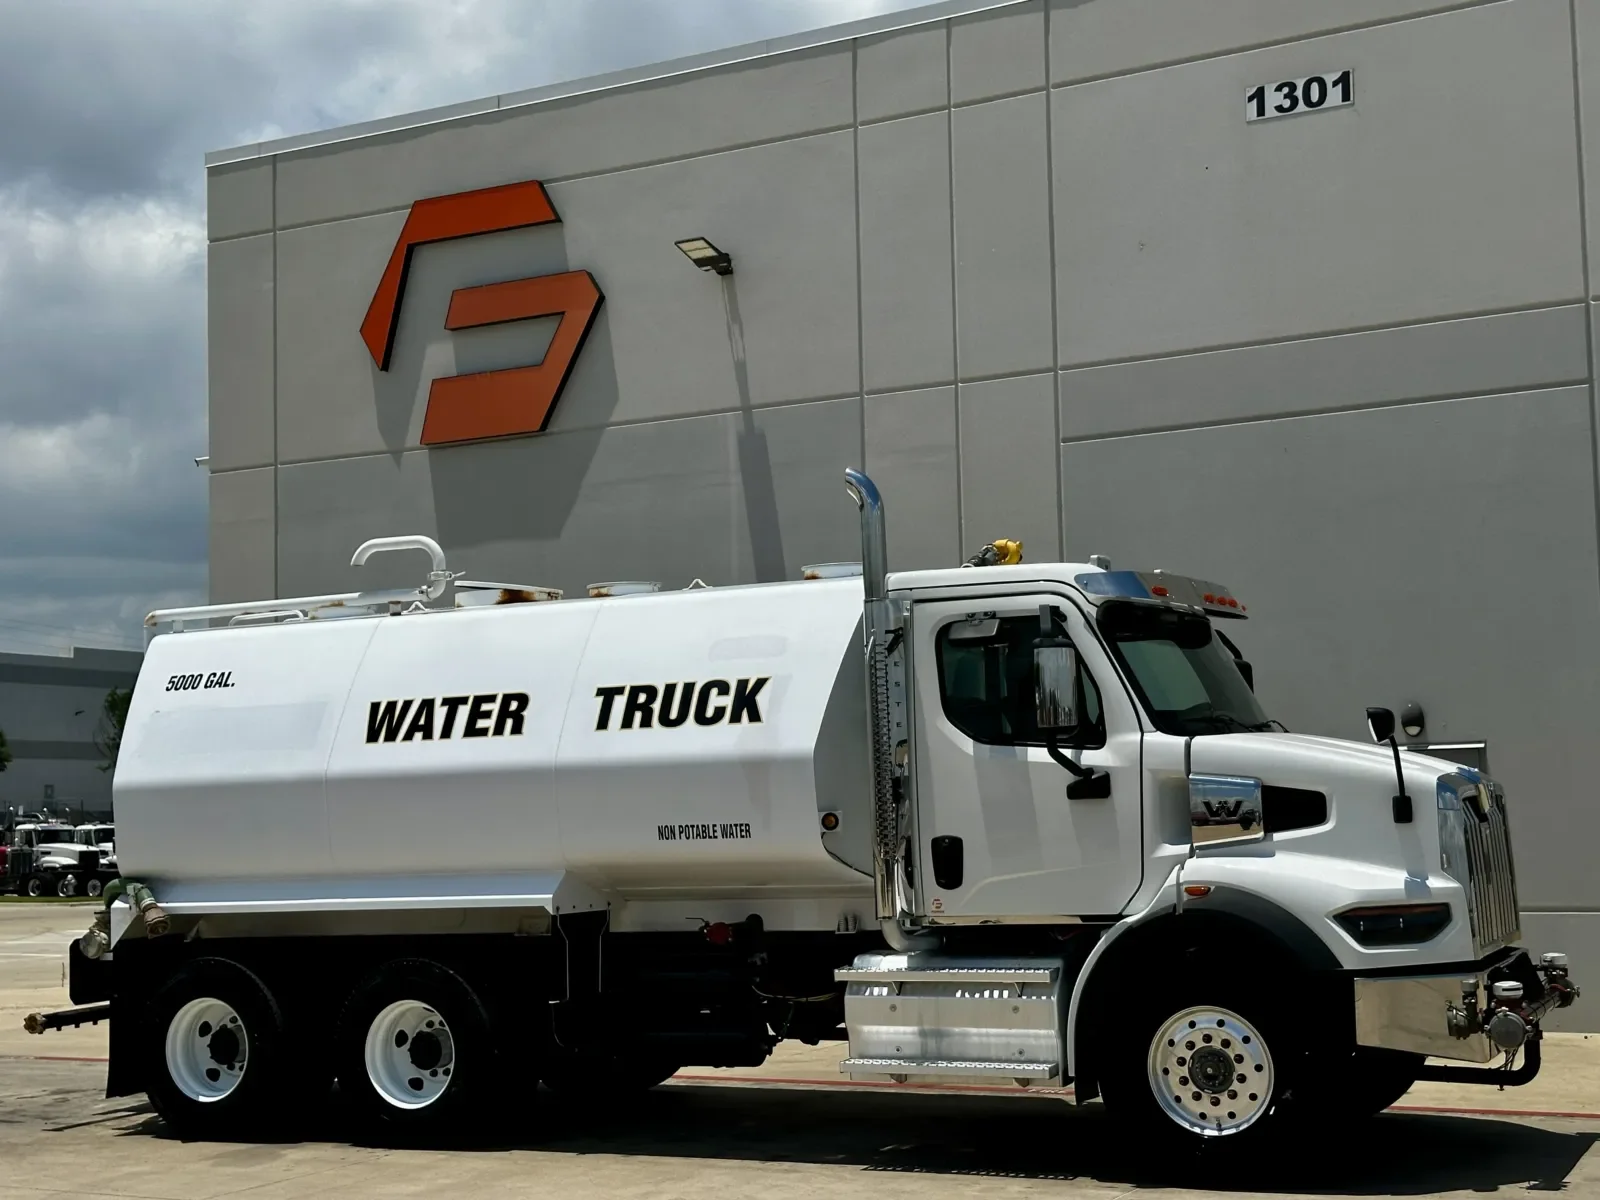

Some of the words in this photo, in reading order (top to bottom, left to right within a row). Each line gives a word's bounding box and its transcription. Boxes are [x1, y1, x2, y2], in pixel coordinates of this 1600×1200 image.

[1247, 70, 1351, 118] 1301
[165, 673, 204, 692] 5000
[203, 671, 236, 690] GAL.
[364, 692, 531, 744] WATER
[594, 676, 772, 732] TRUCK
[657, 824, 677, 841] NON
[677, 823, 719, 841] POTABLE
[719, 822, 752, 839] WATER
